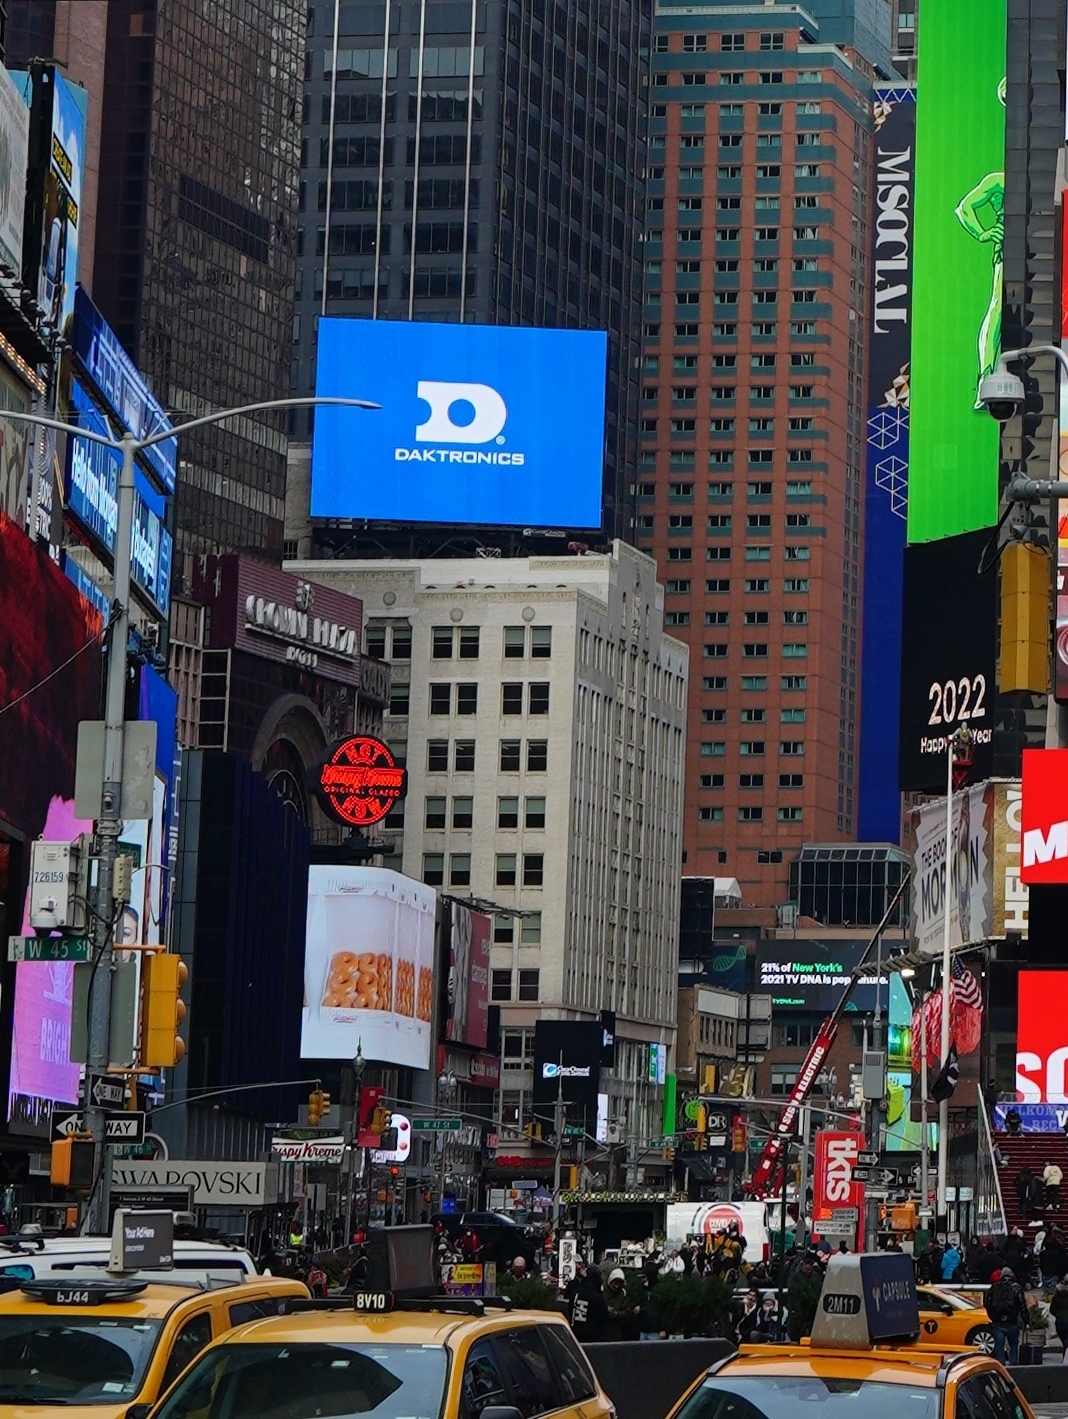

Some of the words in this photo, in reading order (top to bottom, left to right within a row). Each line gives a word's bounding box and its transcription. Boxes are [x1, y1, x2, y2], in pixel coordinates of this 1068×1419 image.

[395, 448, 525, 466] DAKTRONICS
[928, 674, 986, 726] 2022
[933, 837, 948, 863] BOO
[29, 941, 43, 957] W
[51, 940, 69, 958] 45
[781, 962, 792, 973] of
[792, 963, 814, 973] New
[761, 974, 785, 984] 2021
[785, 974, 799, 984] TV
[800, 974, 821, 984] DNA
[832, 976, 852, 986] pop
[65, 1121, 83, 1135] ON
[105, 1122, 132, 1135] WAY
[302, 1142, 342, 1159] Kreme
[826, 1137, 857, 1203] tkts
[882, 1281, 911, 1301] CAPSULE
[356, 1293, 385, 1309] 8V10
[827, 1296, 854, 1313] 2M11
